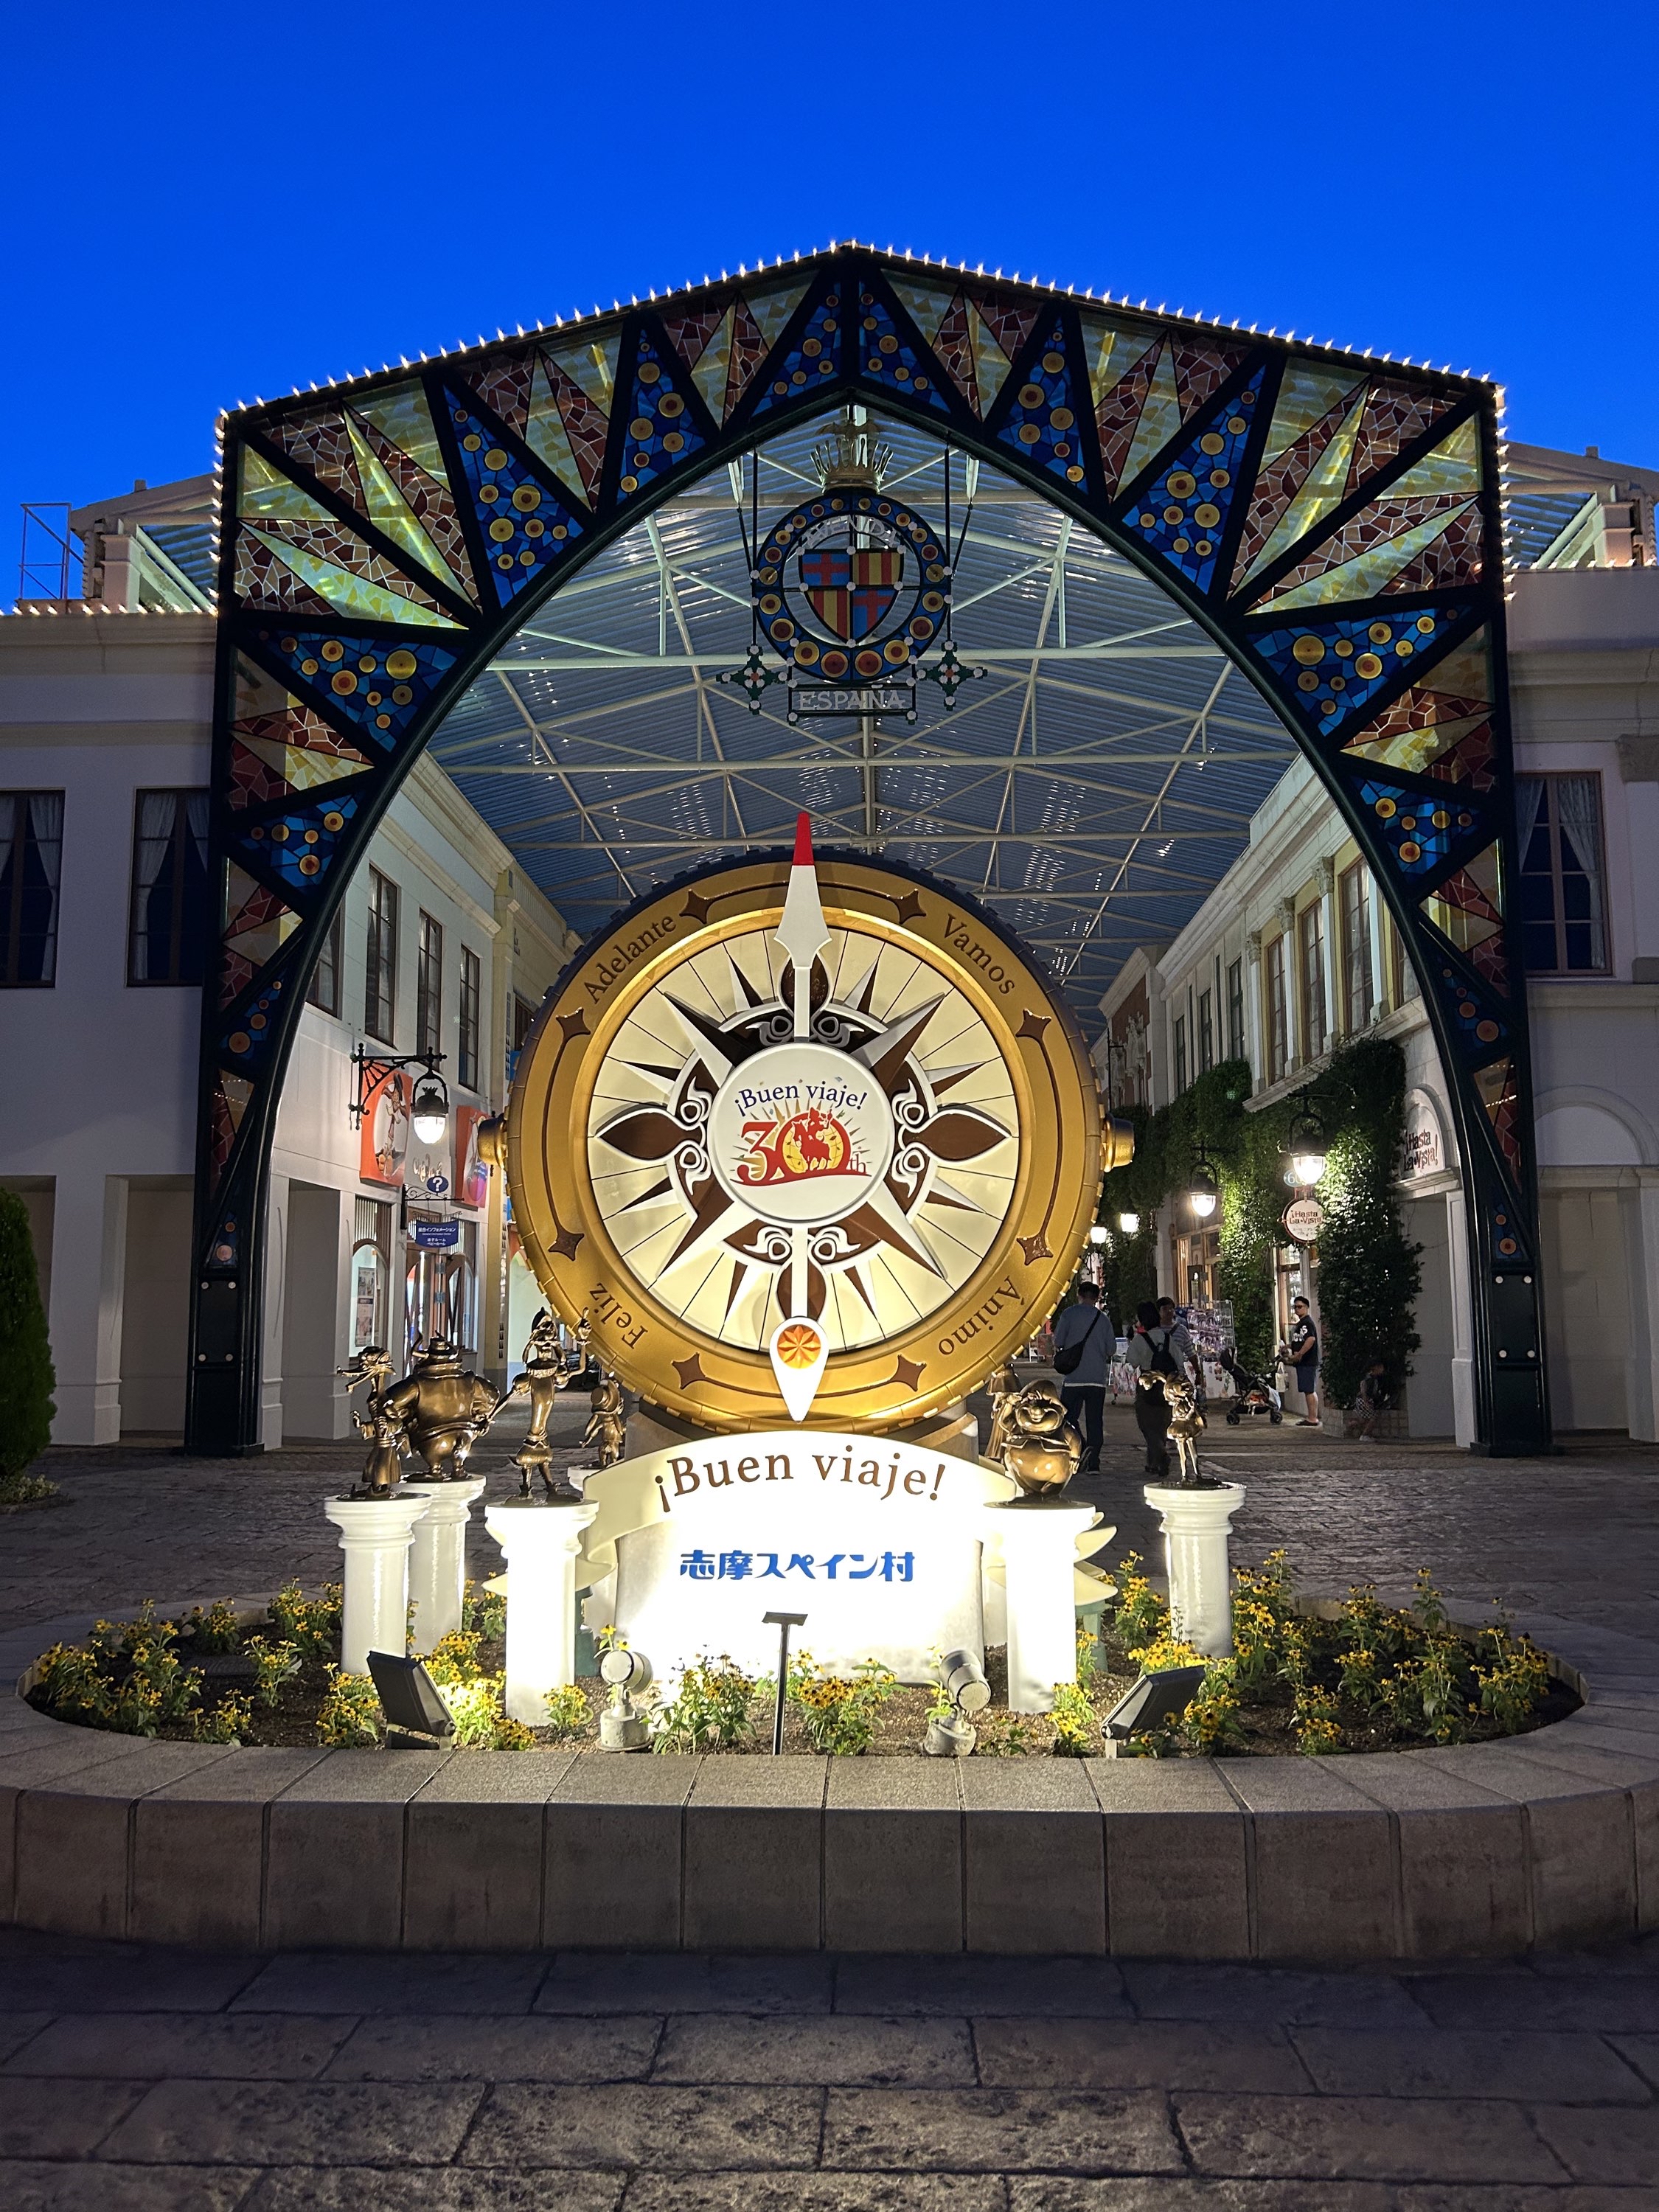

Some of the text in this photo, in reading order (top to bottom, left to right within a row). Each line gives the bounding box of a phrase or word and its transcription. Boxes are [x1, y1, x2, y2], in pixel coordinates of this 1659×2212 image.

[583, 916, 677, 1005] Adelante
[944, 912, 1015, 995] Vamos
[734, 1080, 867, 1117] ¡Buen viaje!
[588, 1281, 649, 1350] Feliz
[938, 1275, 1025, 1355] Ánimo
[655, 1444, 946, 1513] ¡Buen viaje!
[679, 1549, 916, 1582] 志摩スペイン村
